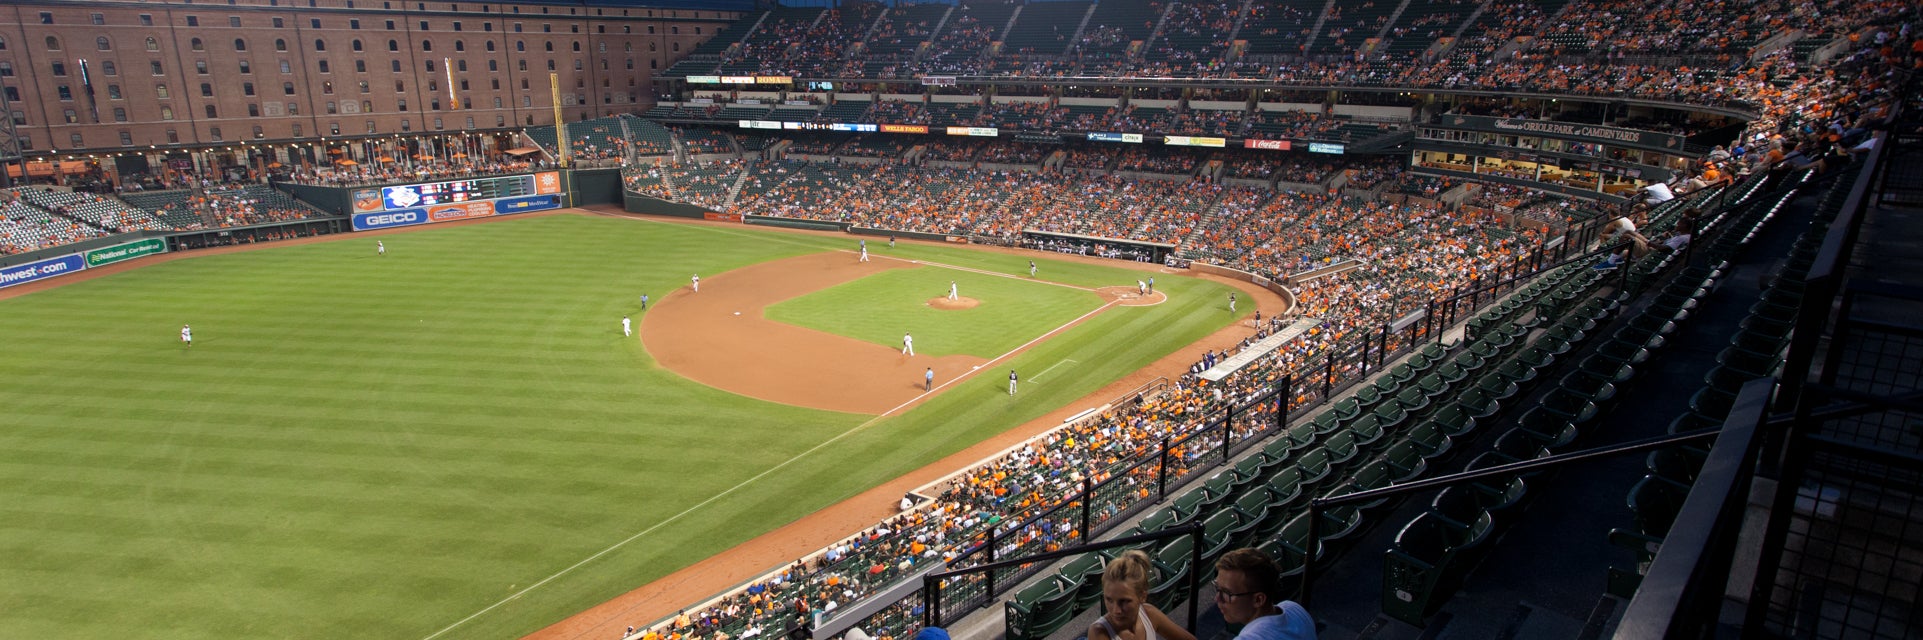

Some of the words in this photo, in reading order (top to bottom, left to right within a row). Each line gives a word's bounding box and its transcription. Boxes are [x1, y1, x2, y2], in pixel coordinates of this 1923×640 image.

[1494, 119, 1518, 129] Welcome
[1523, 122, 1553, 133] ORIOLE
[1553, 124, 1574, 135] PARK
[1581, 127, 1615, 139] CAMDEN
[1615, 131, 1640, 142] YARDS
[366, 212, 417, 226] GEICO
[100, 248, 127, 260] National
